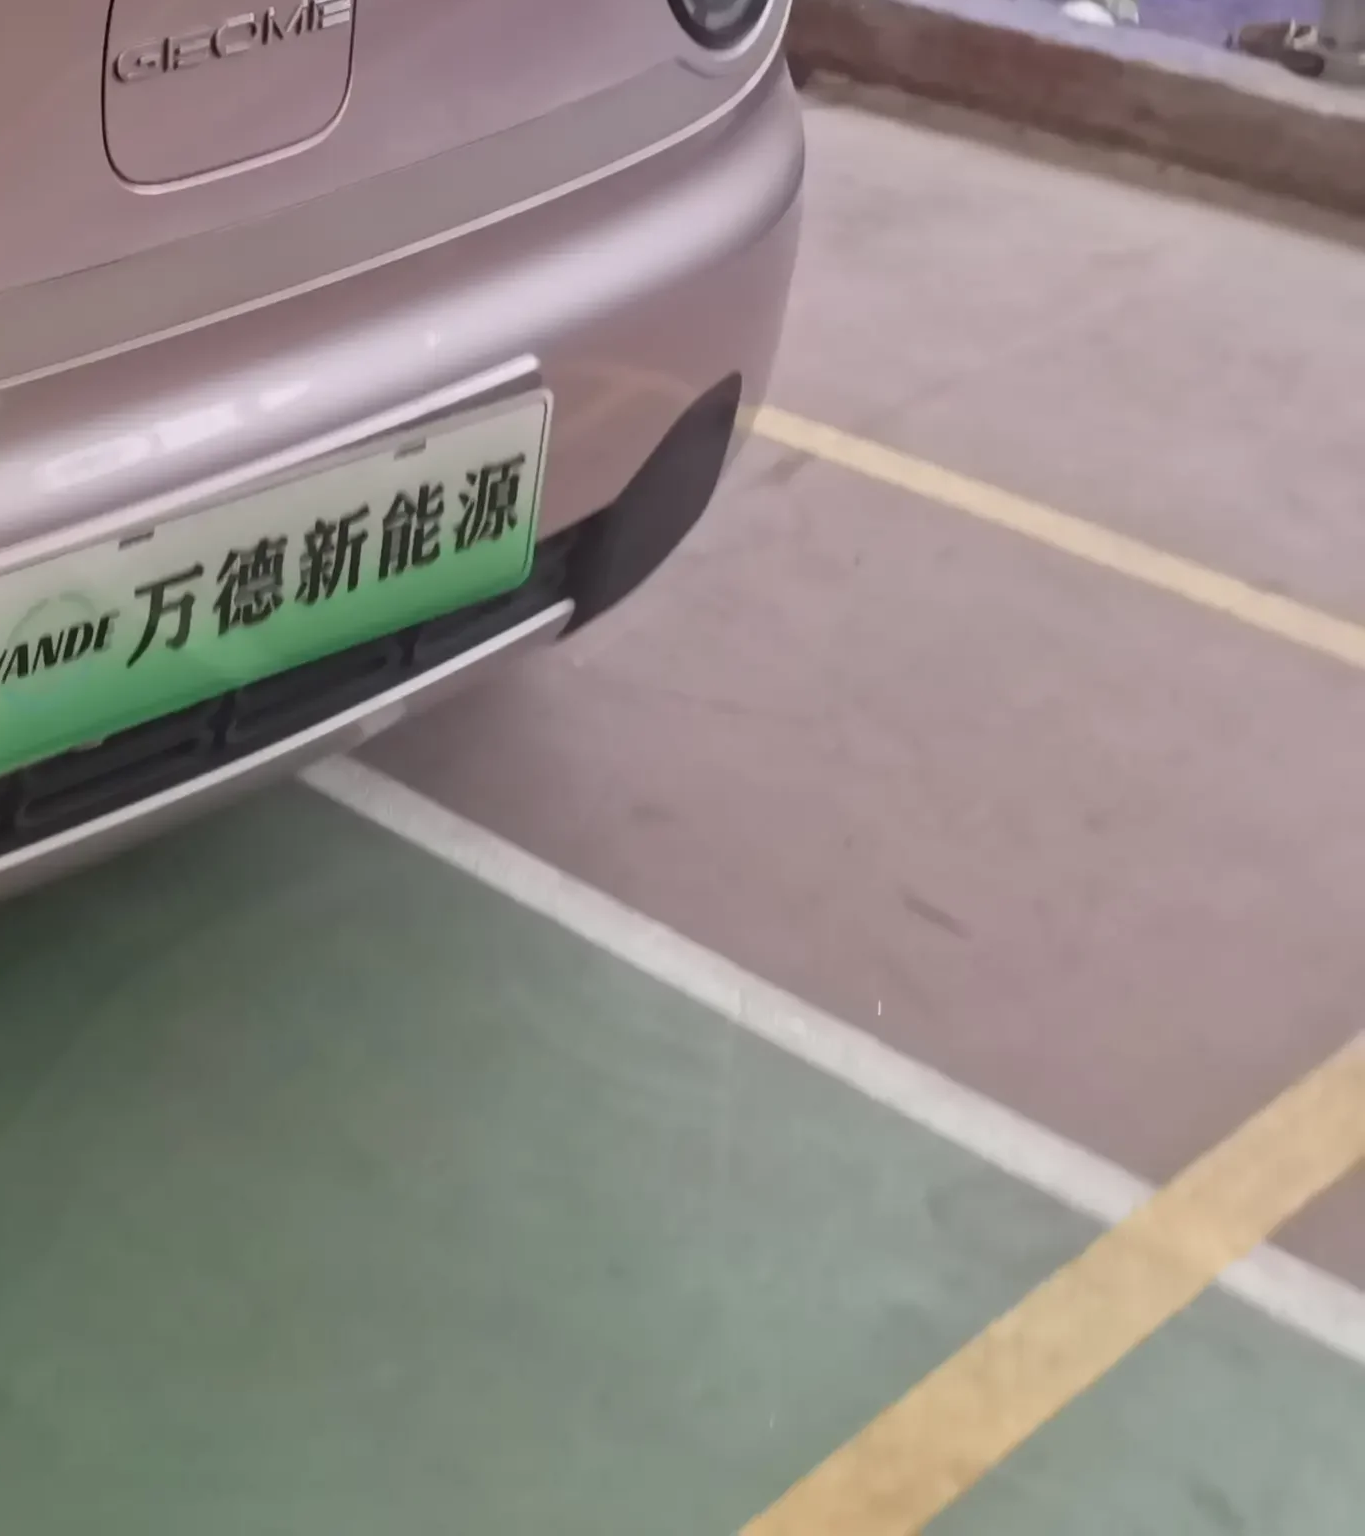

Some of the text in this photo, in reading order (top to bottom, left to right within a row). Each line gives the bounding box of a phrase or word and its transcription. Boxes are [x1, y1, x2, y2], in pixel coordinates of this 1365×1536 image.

[126, 453, 526, 669] 万德新能源
